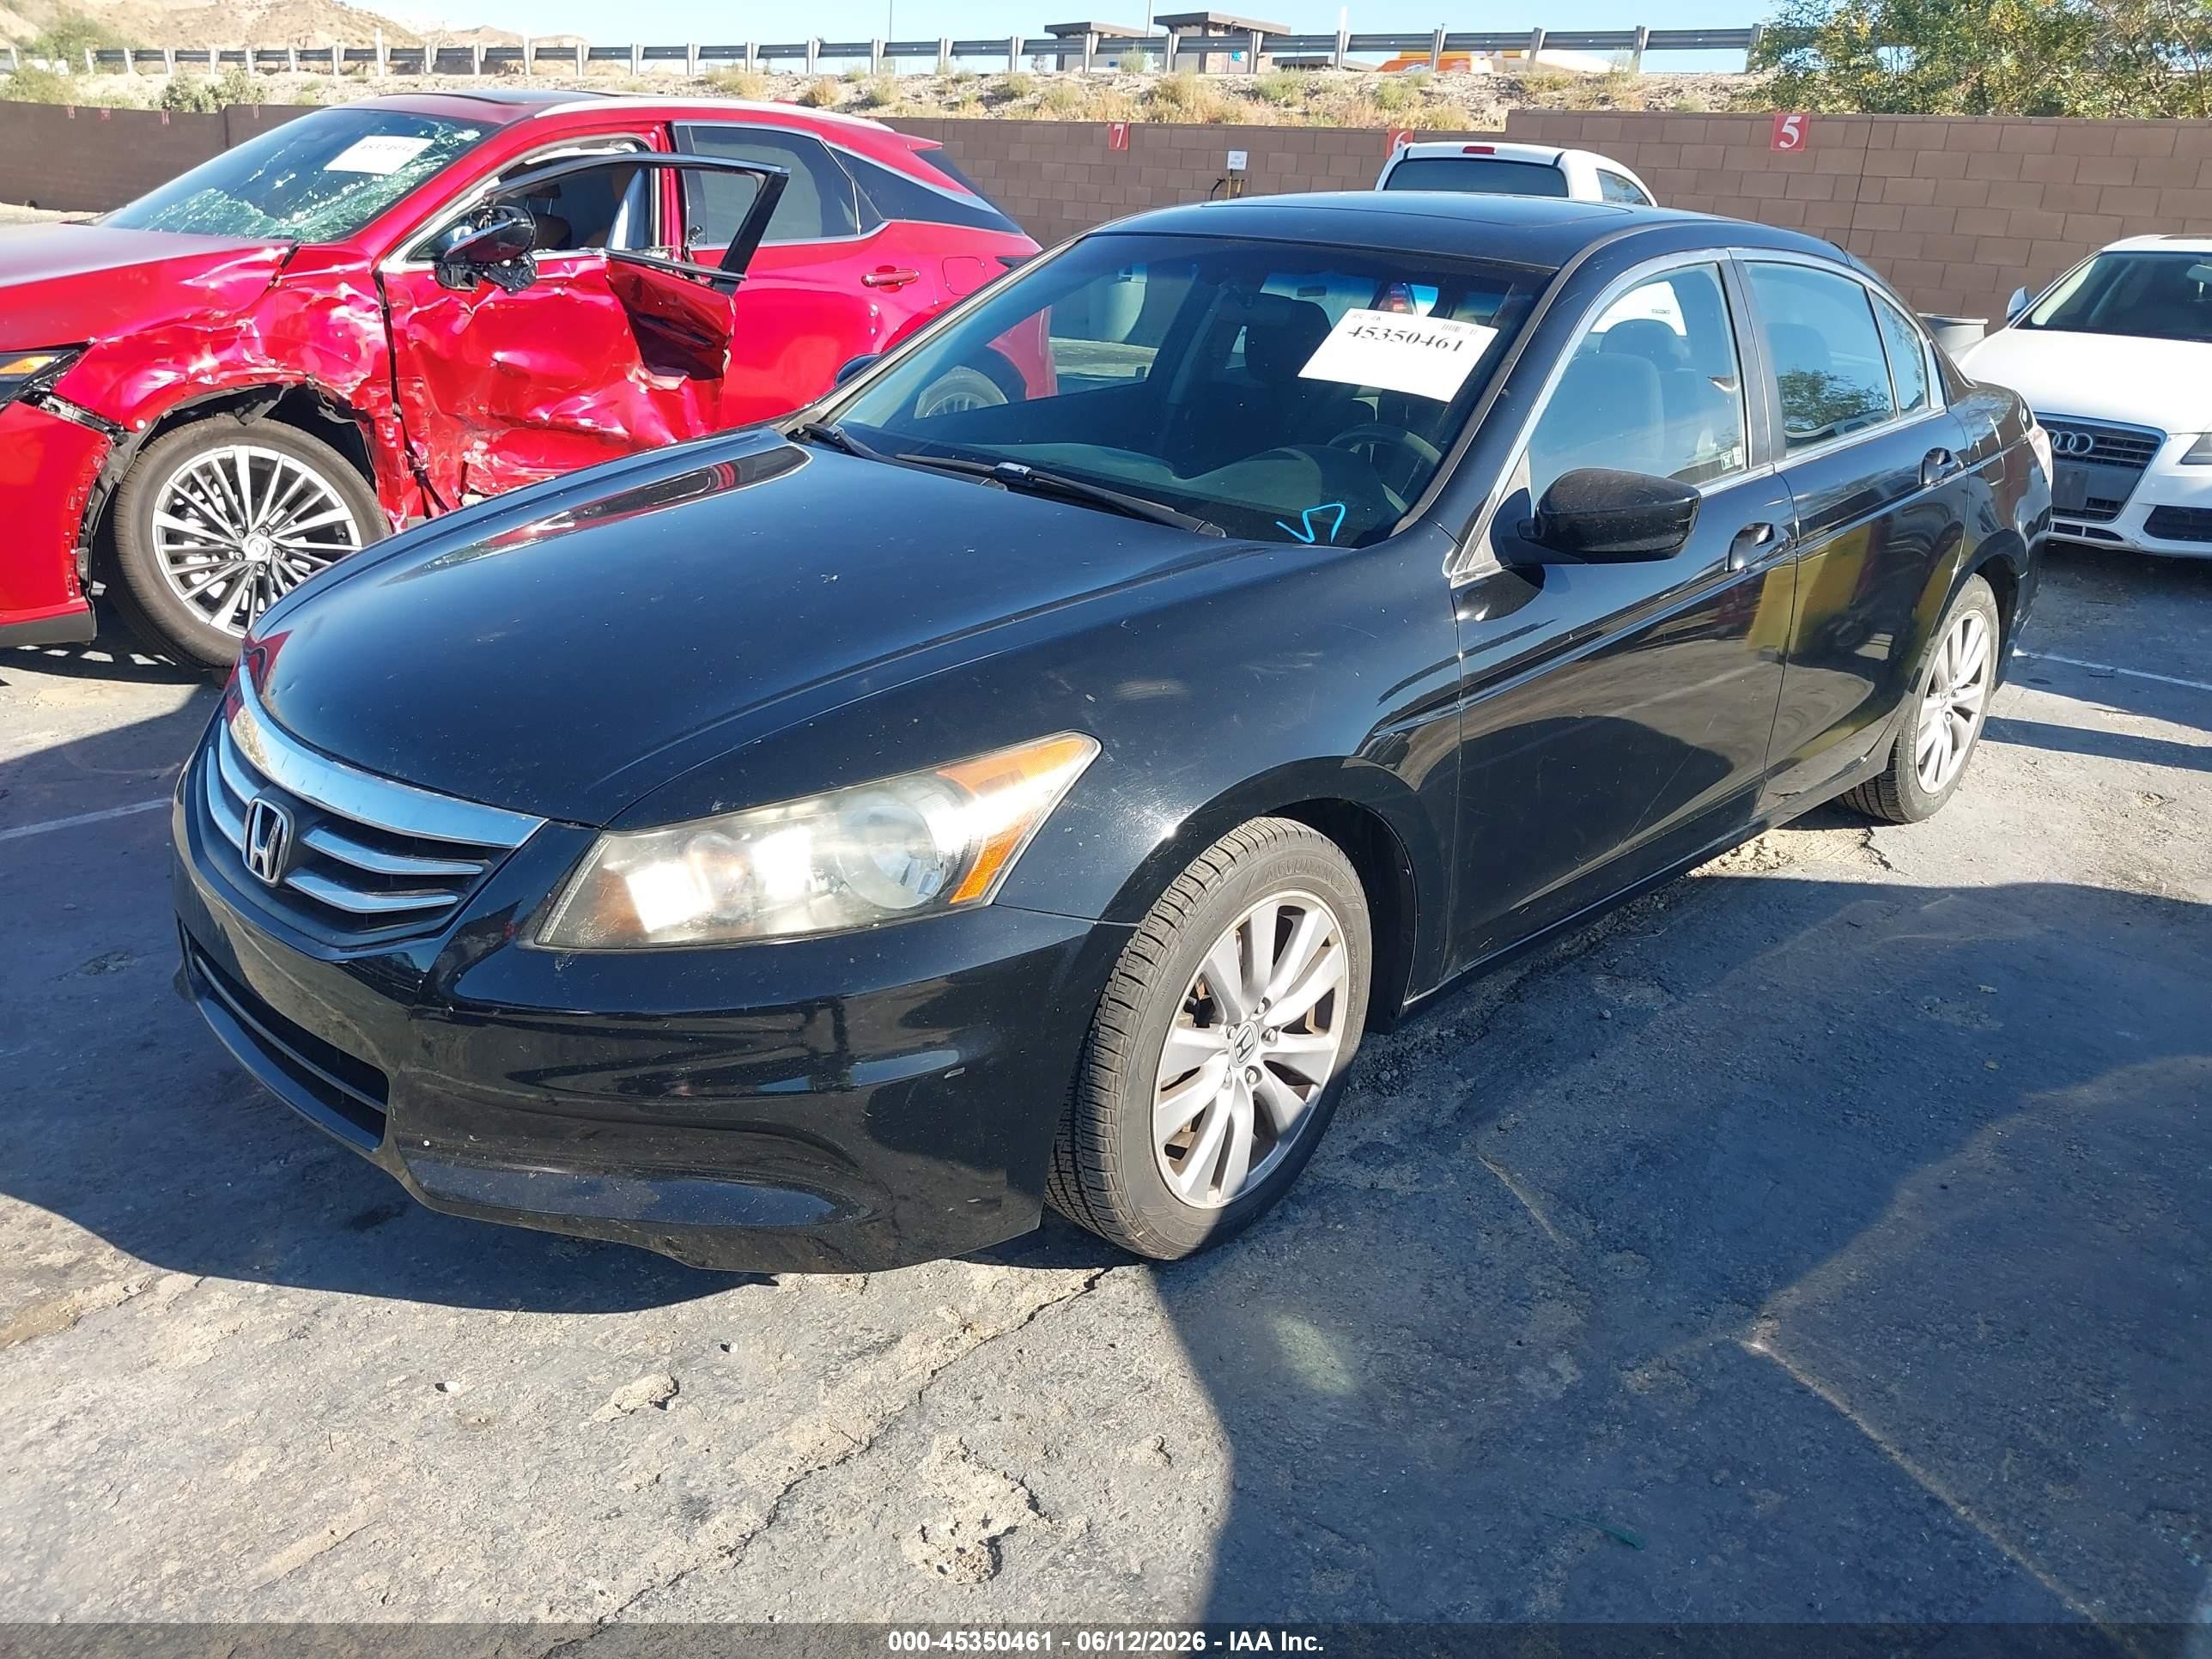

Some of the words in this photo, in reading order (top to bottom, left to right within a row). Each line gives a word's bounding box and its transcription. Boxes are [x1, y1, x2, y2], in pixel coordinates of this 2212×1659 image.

[1113, 124, 1125, 149] 7
[1393, 131, 1409, 152] 6
[1778, 116, 1802, 149] 5
[1347, 325, 1464, 353] 45350461
